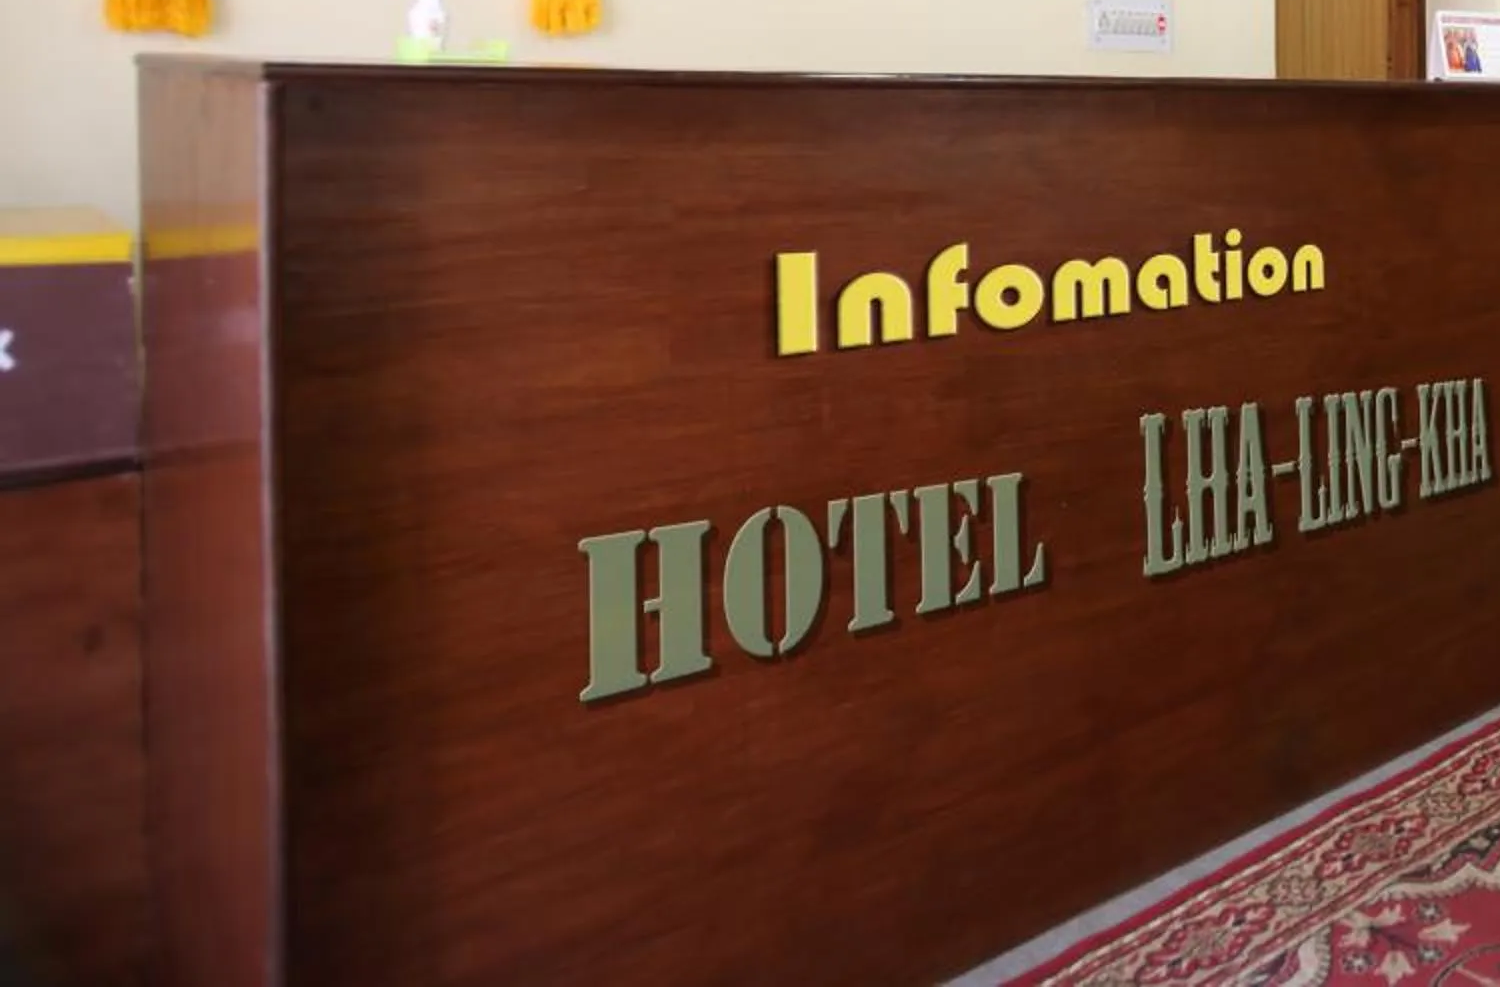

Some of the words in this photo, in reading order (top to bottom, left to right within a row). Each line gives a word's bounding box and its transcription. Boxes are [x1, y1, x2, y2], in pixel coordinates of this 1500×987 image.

[776, 228, 1325, 356] Infomation
[578, 472, 1046, 703] HOTEL
[1139, 378, 1492, 578] LHA-LING-KHA
